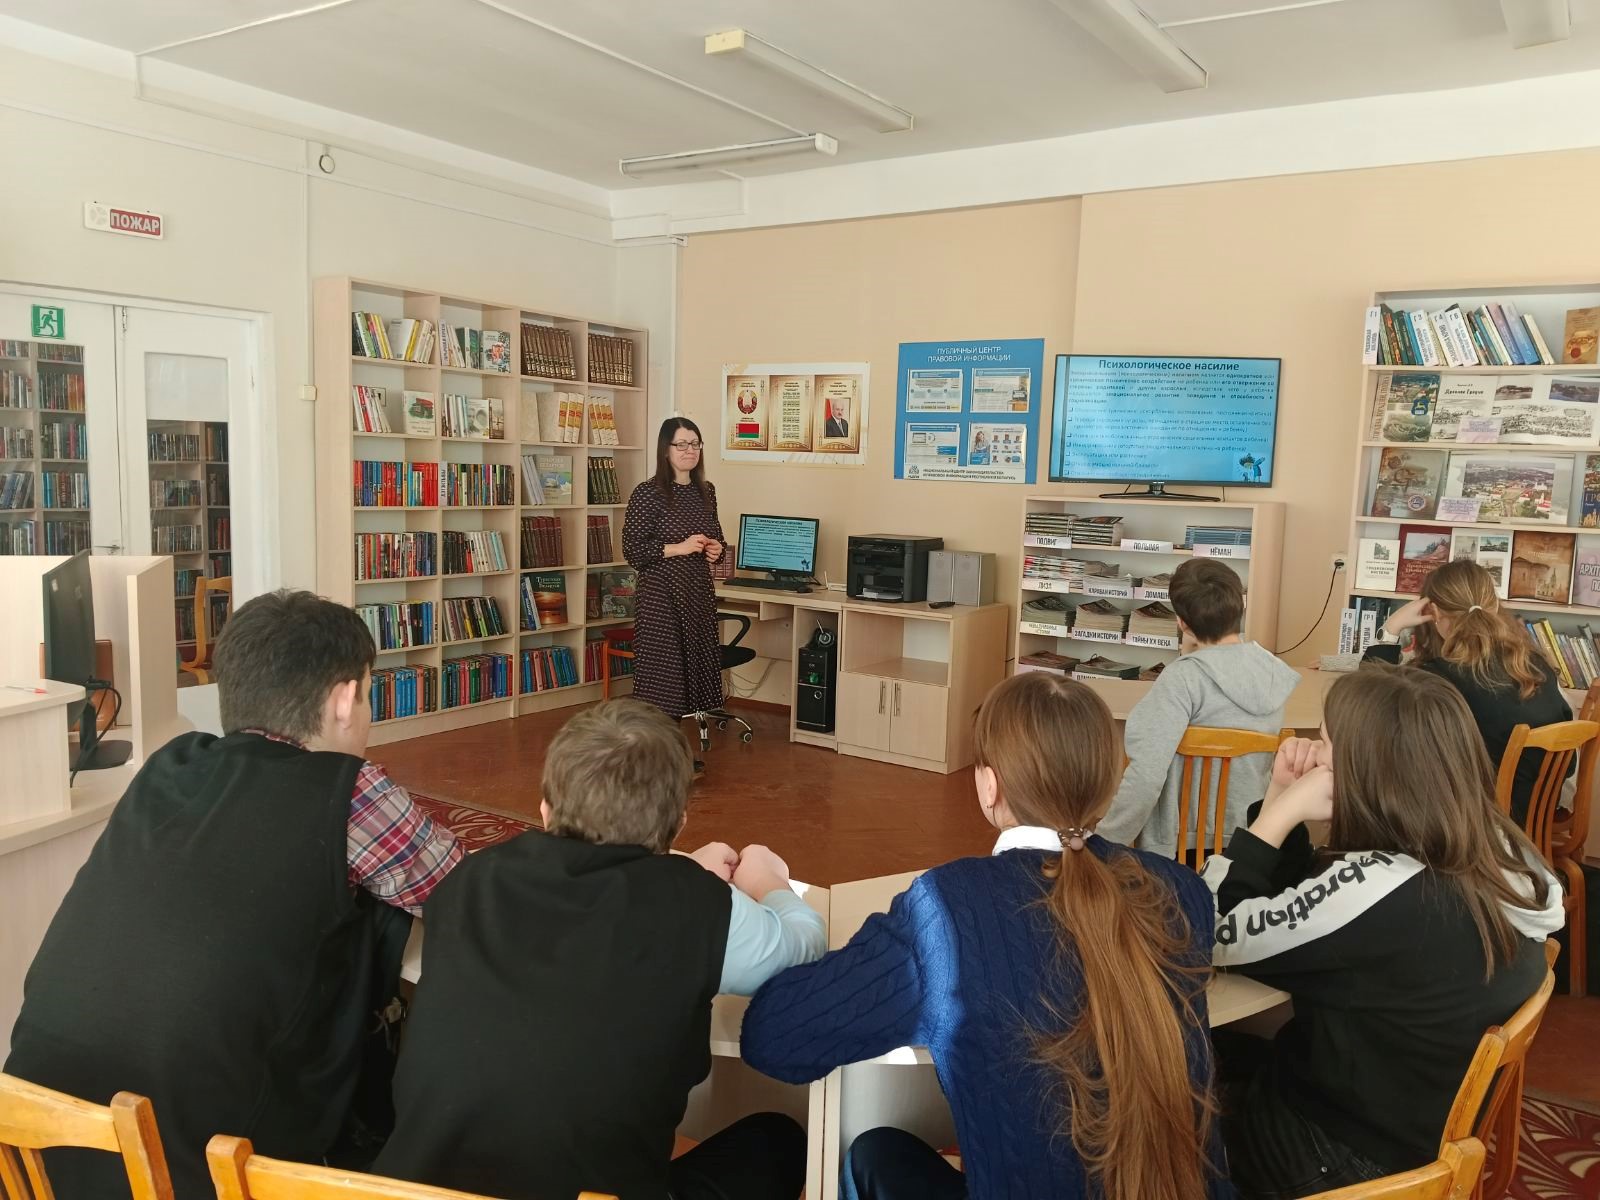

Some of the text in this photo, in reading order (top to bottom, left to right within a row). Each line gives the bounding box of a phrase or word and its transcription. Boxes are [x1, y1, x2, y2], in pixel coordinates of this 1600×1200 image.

[110, 212, 160, 233] ПОЖАР
[978, 346, 1002, 354] ЦЕНТР
[964, 354, 1011, 362] ИНФОРМАЦИИ
[1098, 359, 1239, 371] Психологическое насилие
[1036, 537, 1058, 546] ПОДВИГ
[1210, 546, 1232, 557] НЁМАН
[1038, 582, 1052, 590] ЛИЗА
[1074, 630, 1119, 641] ЗАГАДКИ ИСТОРИИ
[1132, 635, 1149, 644] ТАЙНЫ
[1157, 638, 1171, 647] ВЕКА
